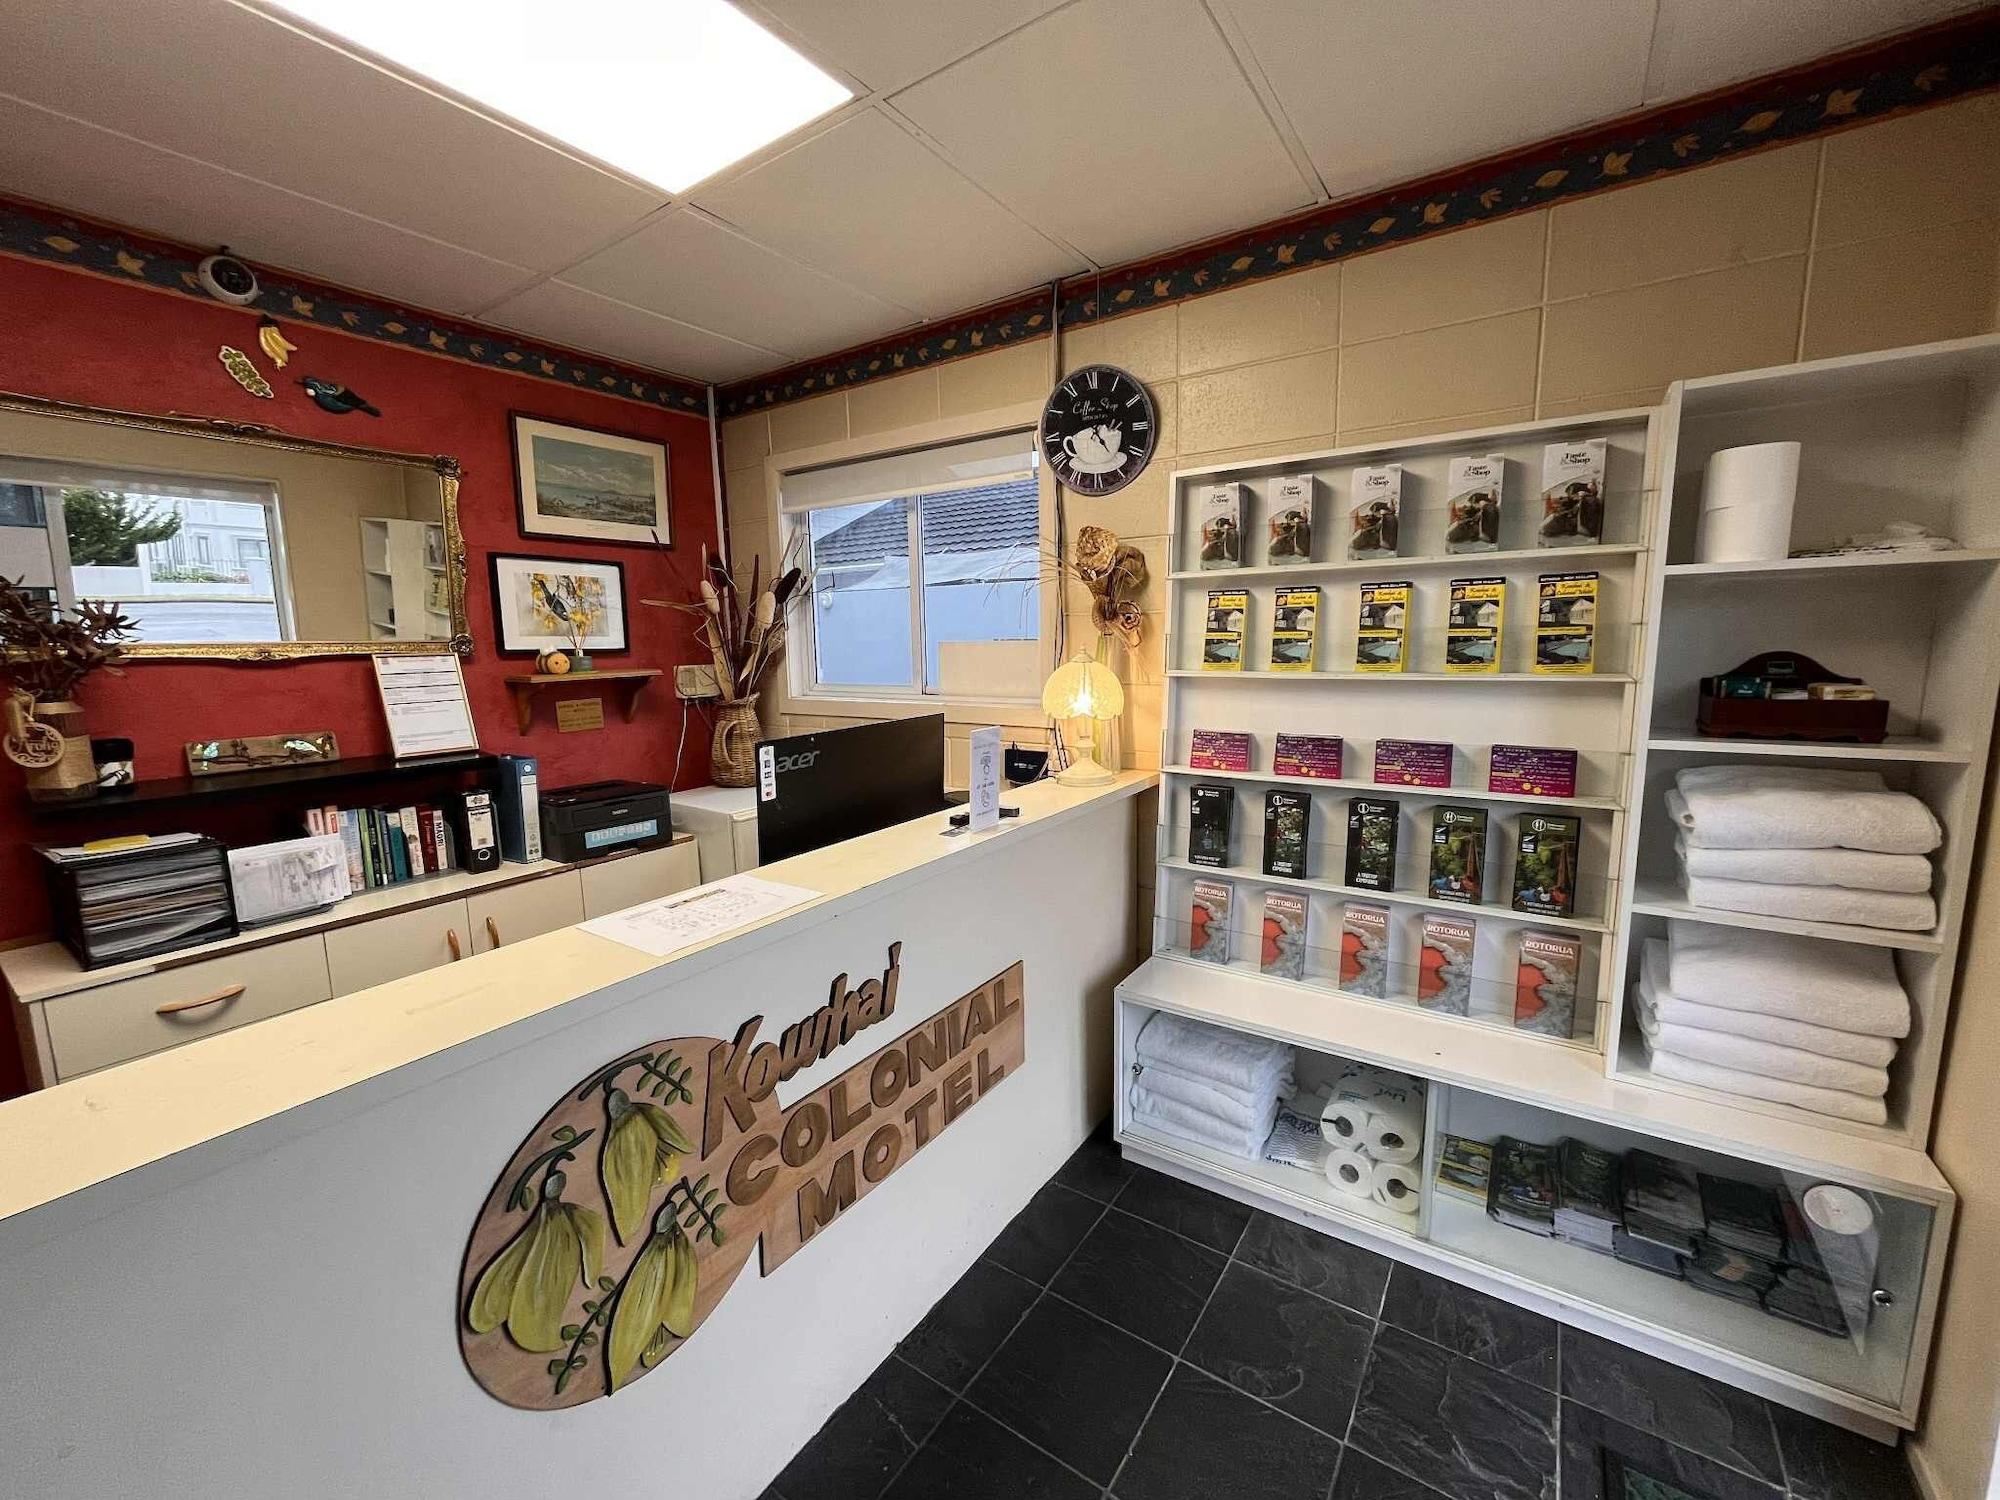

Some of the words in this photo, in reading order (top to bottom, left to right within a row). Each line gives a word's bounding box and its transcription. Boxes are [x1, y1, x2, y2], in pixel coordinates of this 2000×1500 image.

[1565, 451, 1586, 459] Taste
[776, 750, 820, 773] acer
[1195, 885, 1227, 897] ROTORUA
[1266, 898, 1302, 910] ROTORUA
[1344, 911, 1385, 924] ROTORUA
[1427, 923, 1470, 938] ROTORUA
[1525, 940, 1574, 955] ROTORUA
[702, 940, 902, 1160] Kowhai
[725, 976, 1020, 1206] COLONIAL
[798, 1047, 1004, 1242] MOTEL
